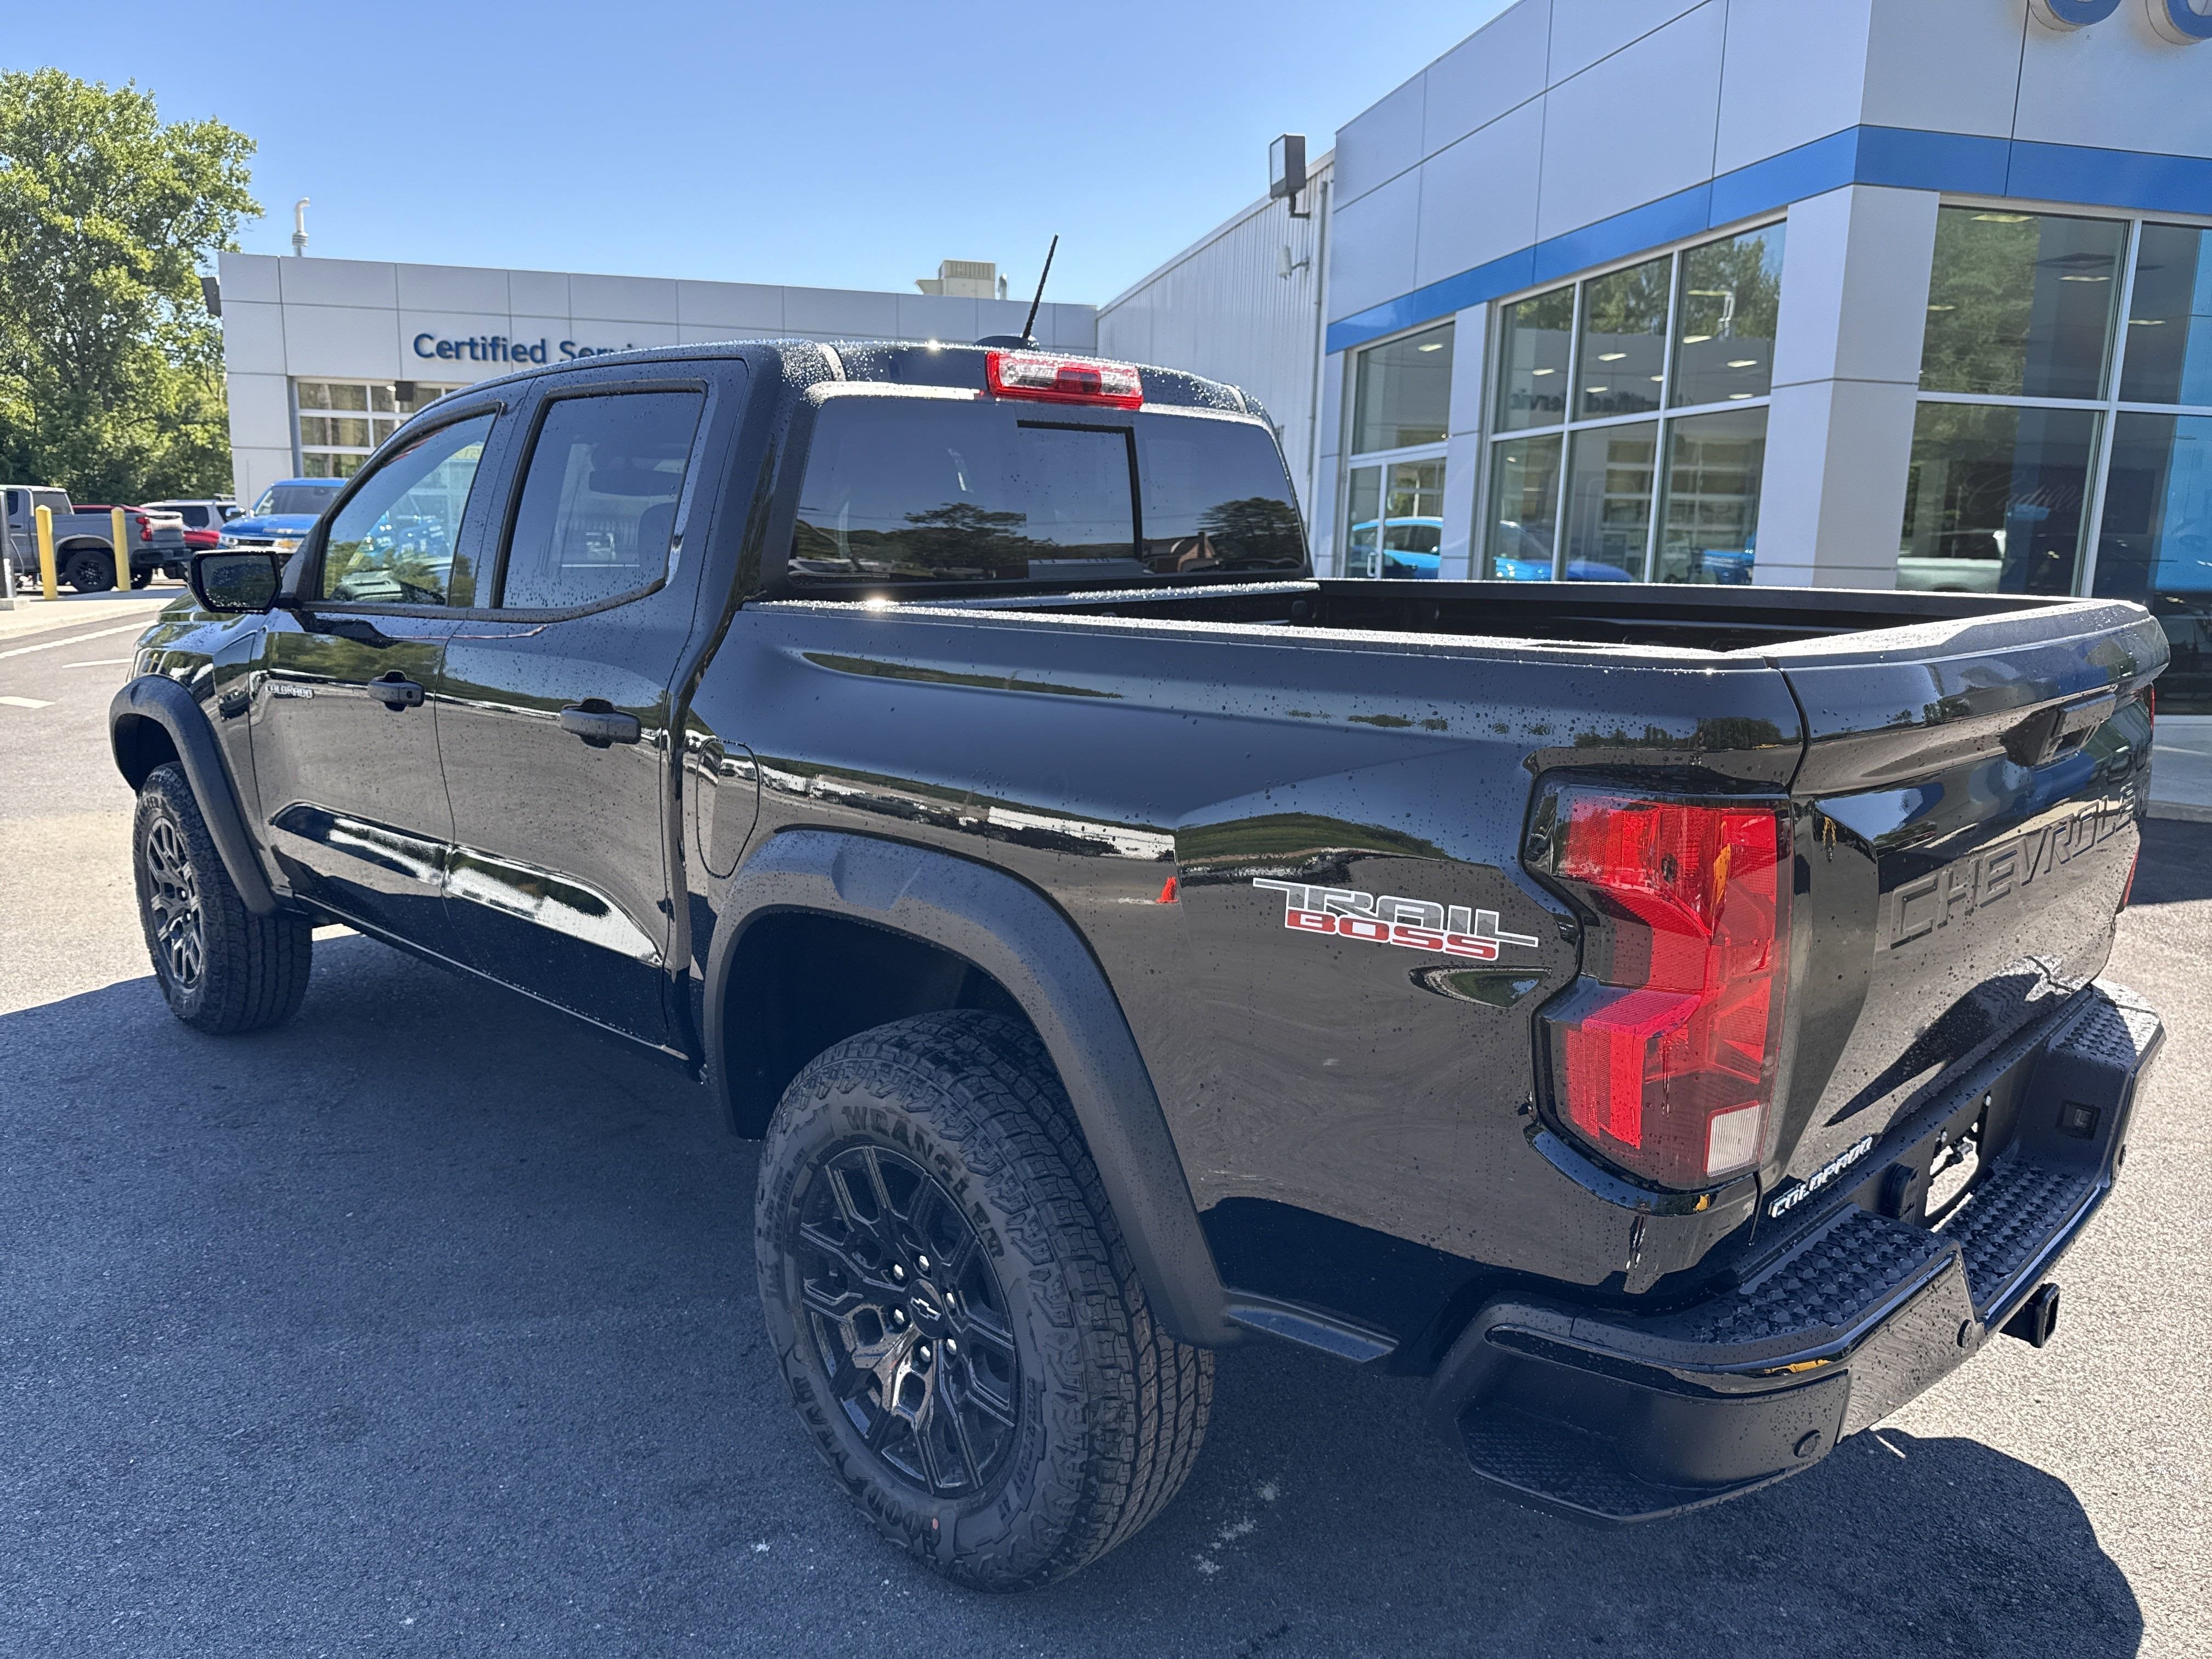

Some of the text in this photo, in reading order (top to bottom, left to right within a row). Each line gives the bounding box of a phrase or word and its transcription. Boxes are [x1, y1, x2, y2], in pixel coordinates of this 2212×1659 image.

[414, 333, 547, 363] Certified
[265, 685, 313, 698] COLORADO
[1253, 878, 1538, 947] TRAIL
[1285, 909, 1499, 961] BOSS
[1768, 1136, 1873, 1217] COLORADO
